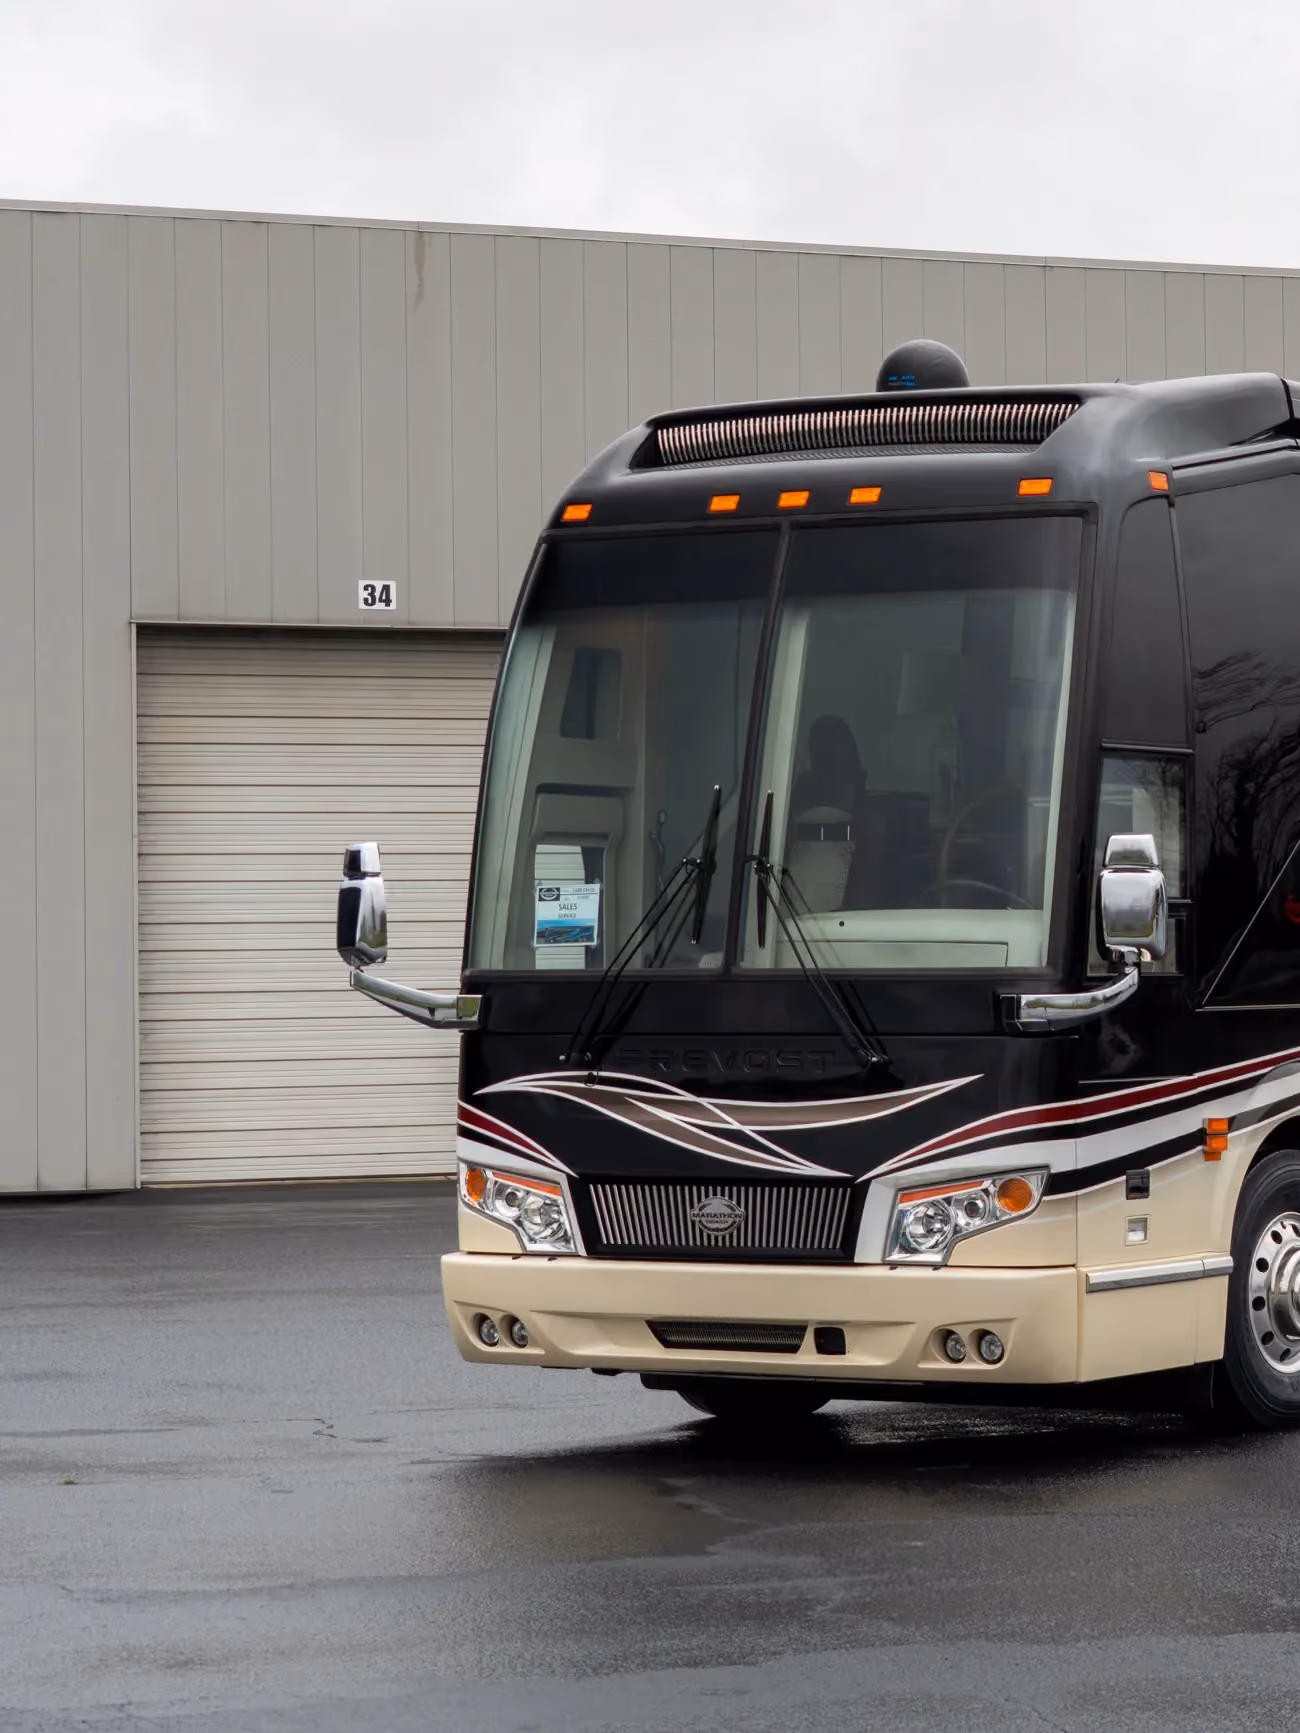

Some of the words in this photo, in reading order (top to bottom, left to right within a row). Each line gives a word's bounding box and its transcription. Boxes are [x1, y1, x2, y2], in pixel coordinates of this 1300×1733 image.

[363, 584, 392, 607] 34
[558, 903, 577, 911] SALES
[618, 1050, 836, 1073] PREVOST
